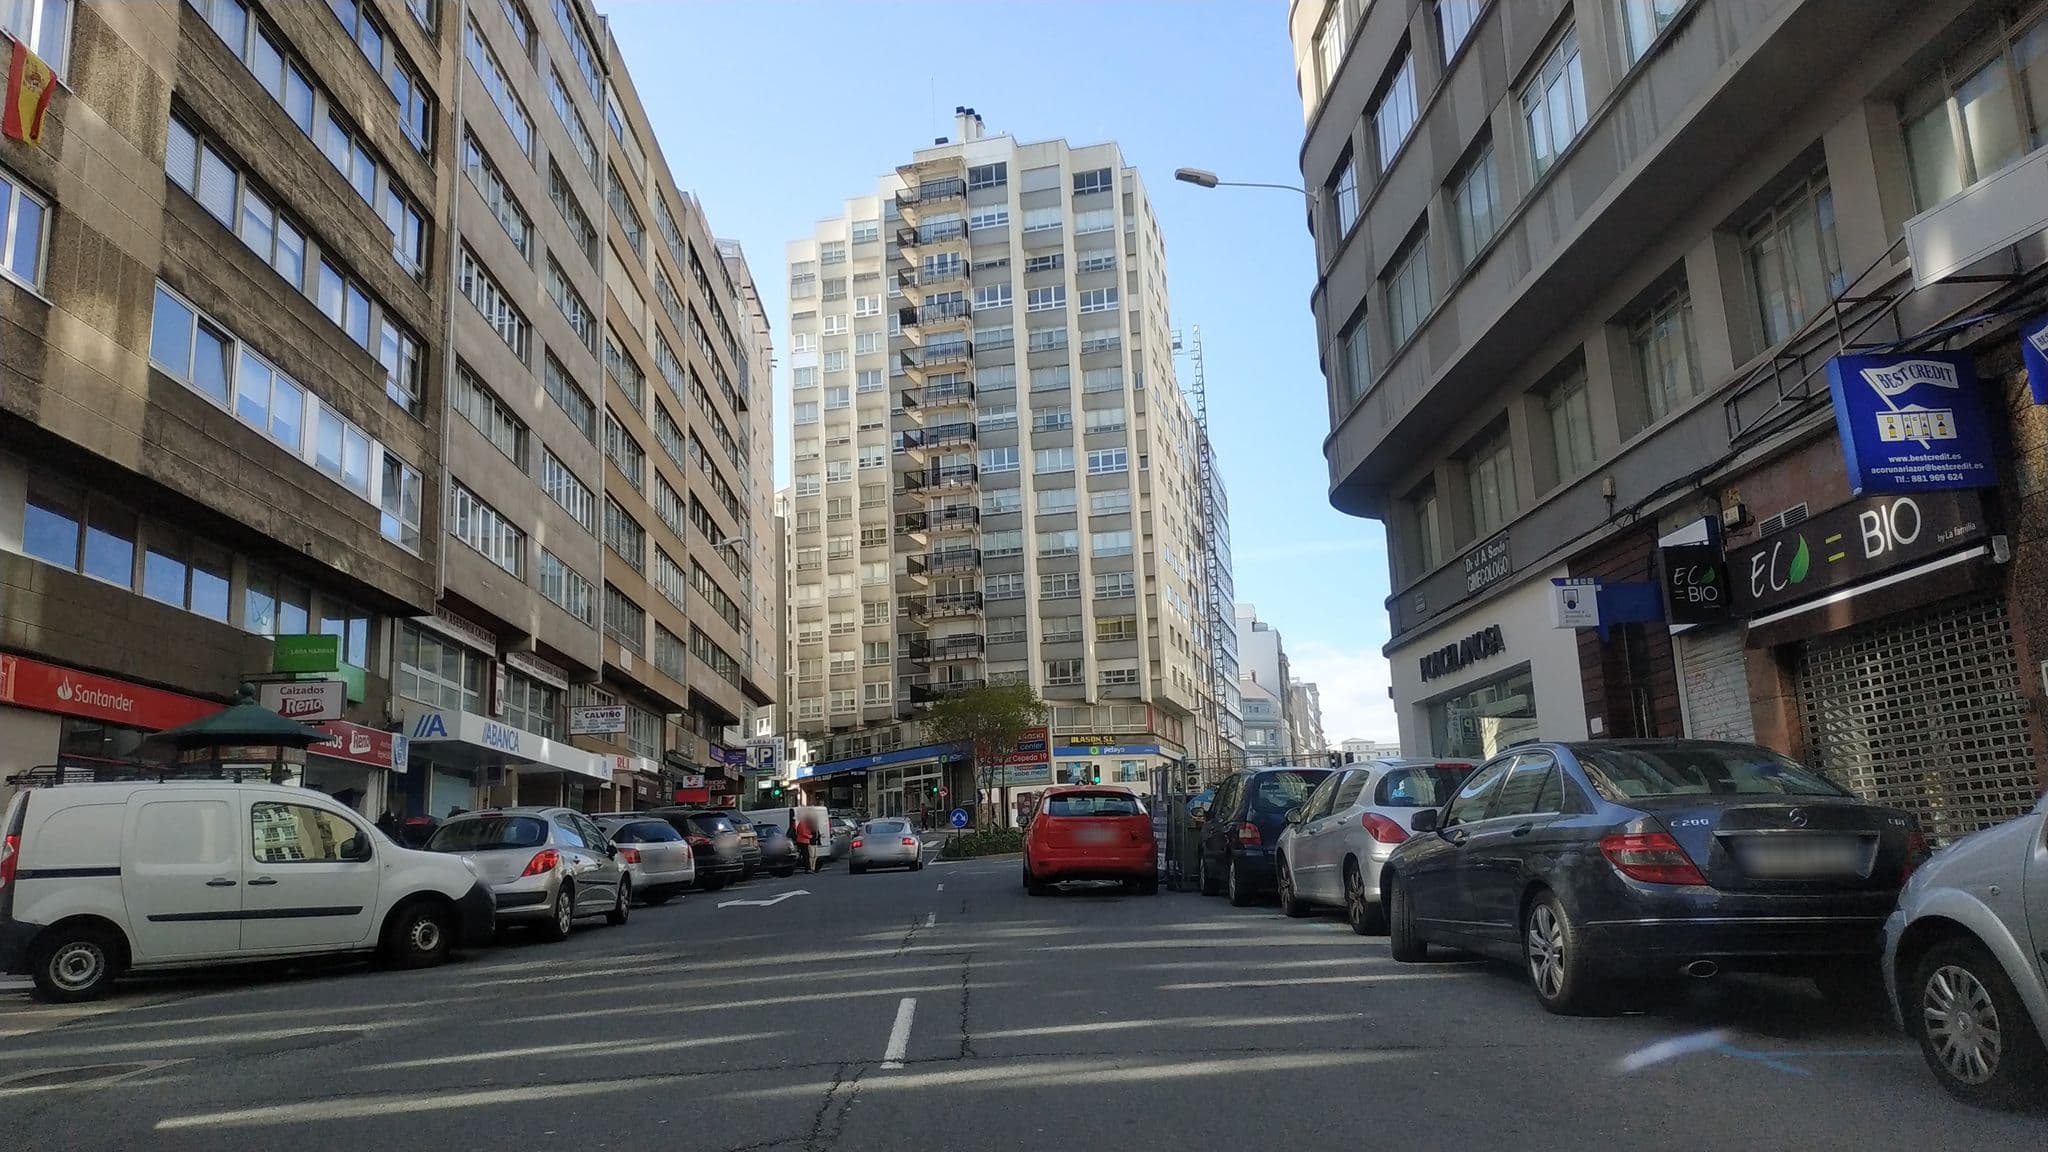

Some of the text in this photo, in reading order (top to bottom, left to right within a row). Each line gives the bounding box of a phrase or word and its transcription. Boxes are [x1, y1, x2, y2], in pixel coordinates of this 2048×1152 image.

[1876, 364, 1953, 389] BEST CREDIT
[1888, 453, 1961, 463] www.bestcredit.es
[1911, 474, 1928, 484] 881
[1929, 473, 1945, 482] 969
[1947, 472, 1963, 482] 624
[1860, 497, 1921, 560] BIO
[1688, 585, 1718, 602] BIO
[280, 686, 325, 696] Calzados
[74, 684, 135, 712] Santander
[285, 699, 322, 714] Reno
[584, 710, 621, 719] CALVIÑO
[760, 748, 772, 763] P
[1013, 754, 1037, 762] Cepeda
[1040, 752, 1047, 760] 19
[1681, 819, 1709, 827] 200
